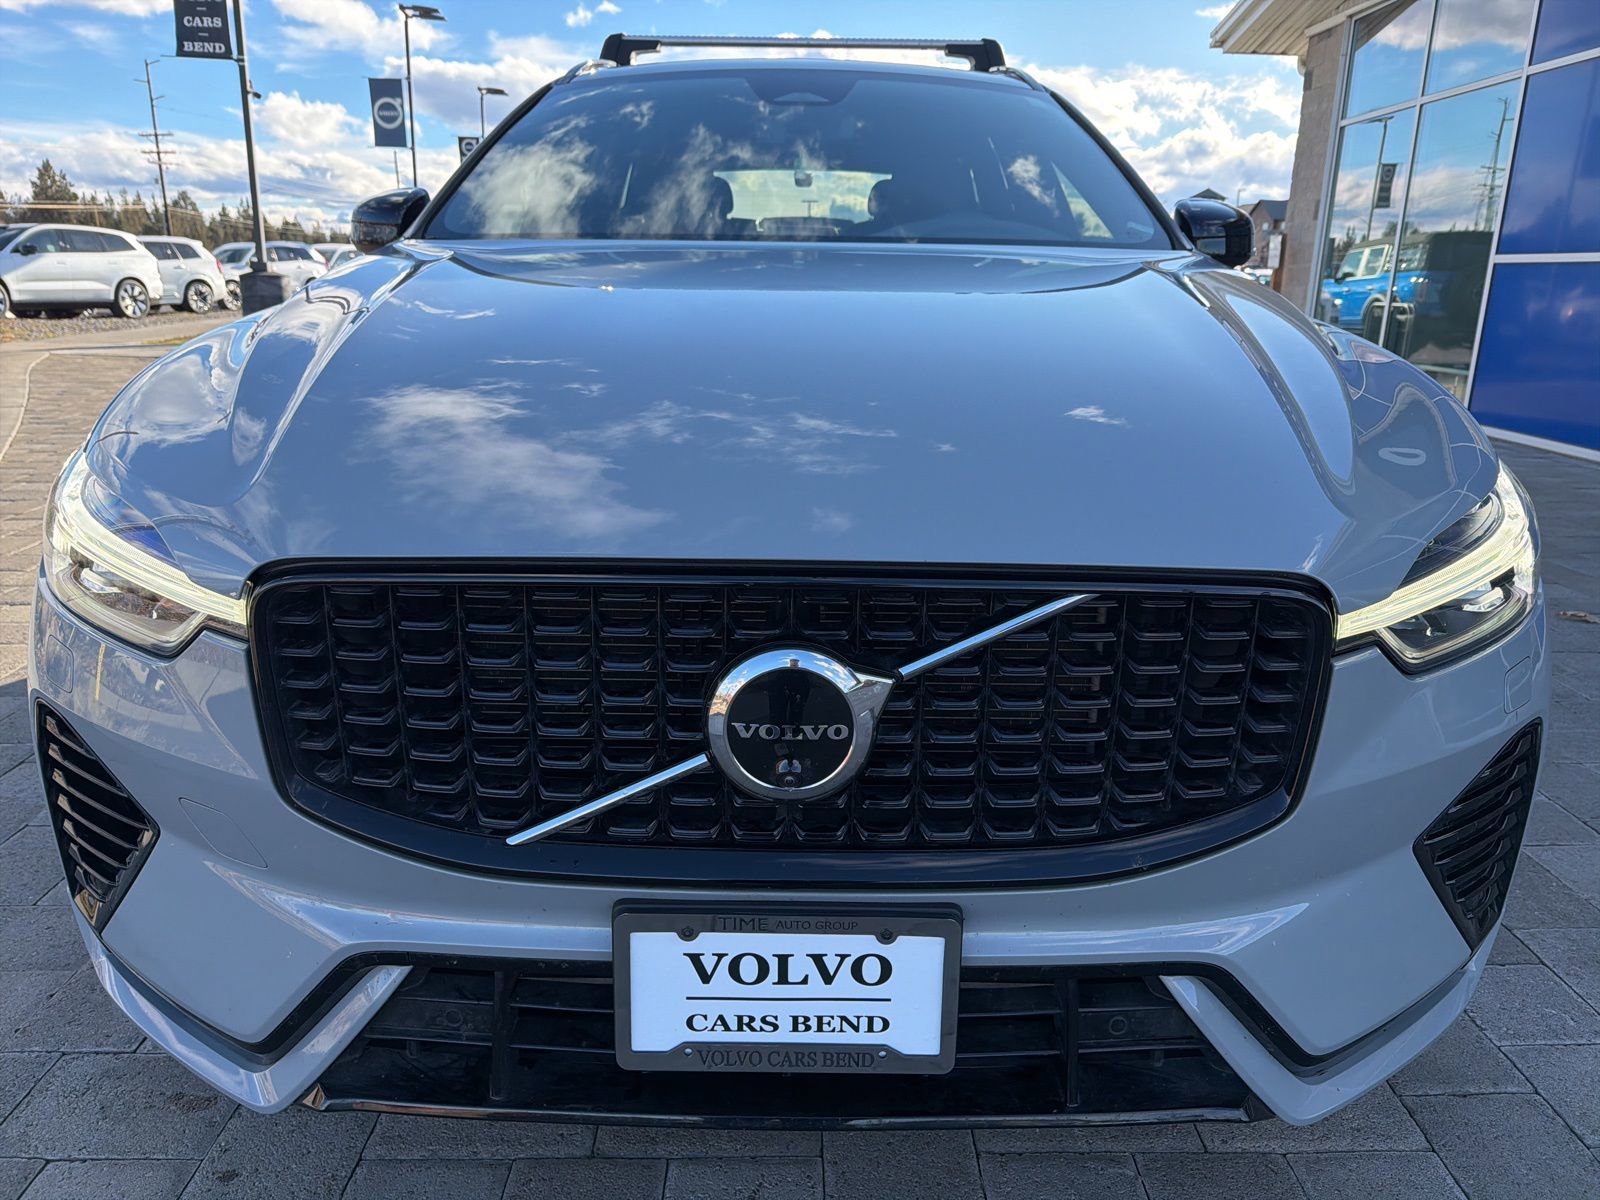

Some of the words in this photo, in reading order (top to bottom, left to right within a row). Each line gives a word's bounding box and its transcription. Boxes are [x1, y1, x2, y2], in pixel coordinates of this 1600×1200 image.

[183, 16, 222, 27] CARS
[183, 42, 225, 53] BEND
[731, 722, 849, 741] VOLVO
[718, 917, 769, 931] TIME
[776, 920, 811, 930] AUTO
[815, 921, 858, 931] GROUP
[683, 952, 893, 986] VOLVO
[686, 1014, 779, 1033] CARS
[789, 1015, 890, 1034] BEND
[697, 1050, 764, 1066] VOLVO
[767, 1051, 818, 1068] CARS
[822, 1052, 875, 1068] BEND
